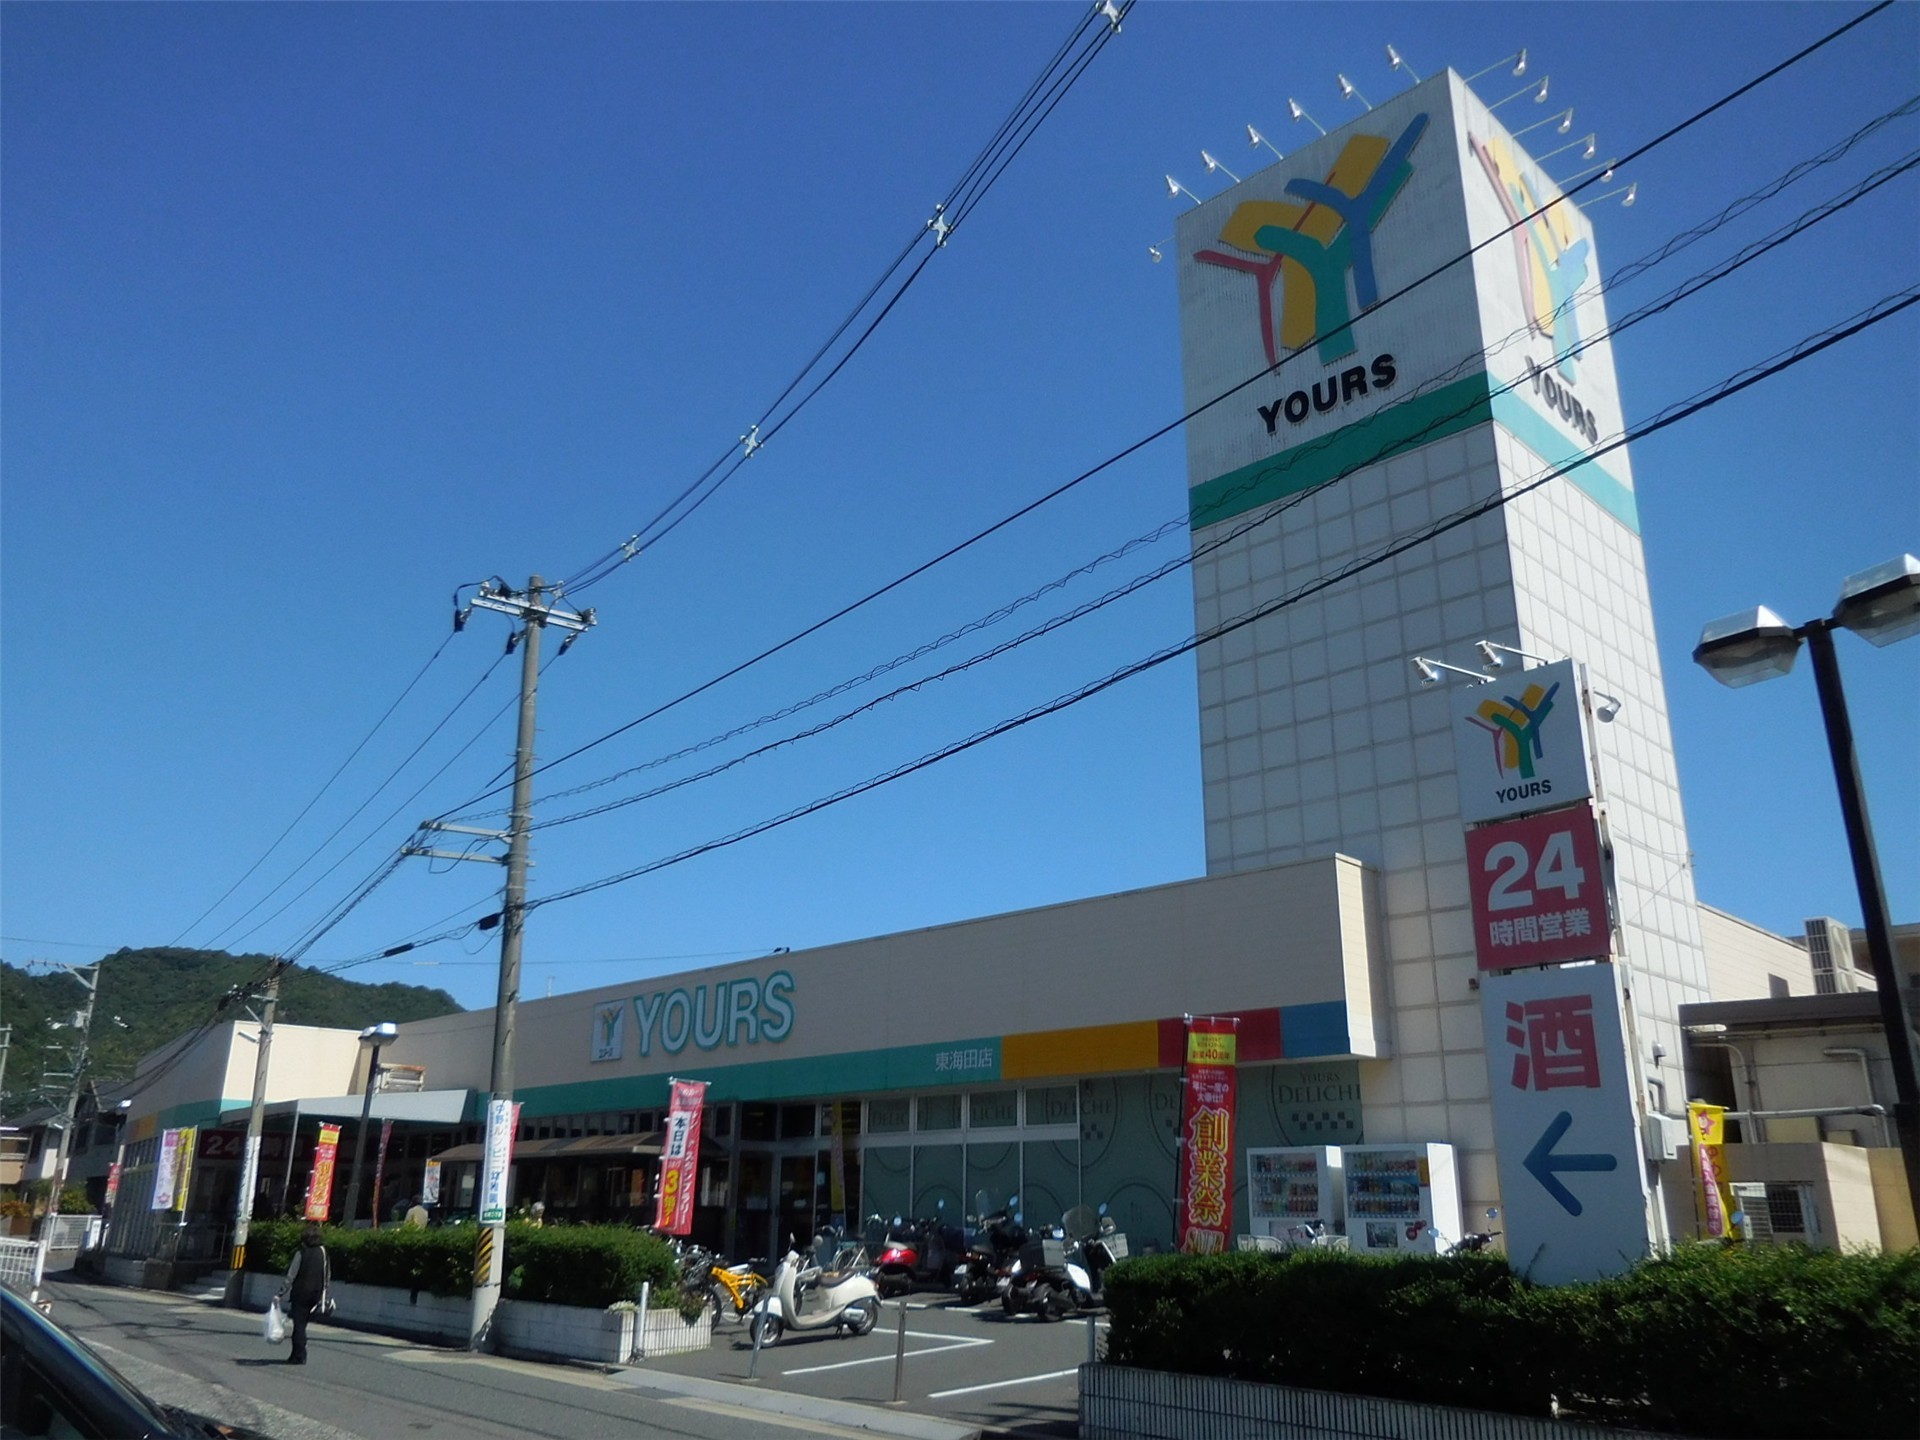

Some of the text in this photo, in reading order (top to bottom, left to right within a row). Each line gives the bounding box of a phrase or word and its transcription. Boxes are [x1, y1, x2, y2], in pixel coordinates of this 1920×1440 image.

[1257, 353, 1397, 435] YOURS
[1525, 356, 1598, 444] YOURS
[1496, 779, 1552, 804] YOURS
[1484, 830, 1586, 912] 24
[1489, 907, 1591, 948] 時間営業
[634, 969, 796, 1057] YOURS
[1504, 992, 1600, 1092] 酒
[935, 1047, 993, 1071] 東海田店
[670, 1116, 687, 1156] 本日は
[1188, 1105, 1229, 1227] 創業祭
